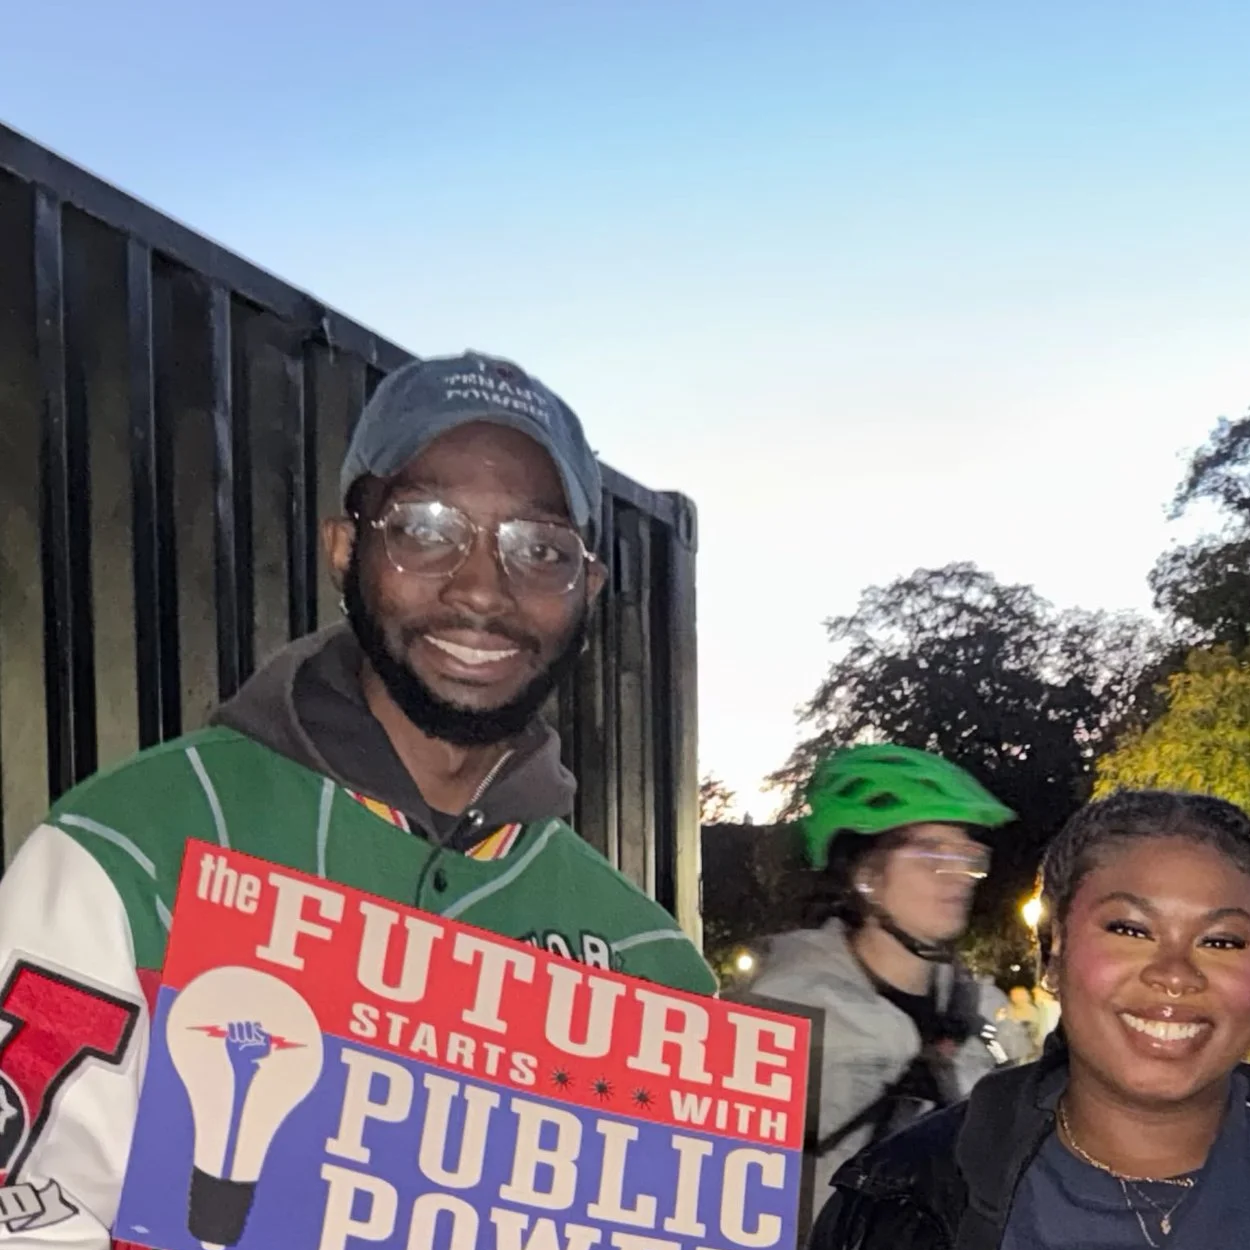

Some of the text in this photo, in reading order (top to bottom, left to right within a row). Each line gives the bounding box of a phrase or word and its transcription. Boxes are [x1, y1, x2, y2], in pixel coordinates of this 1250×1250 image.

[197, 854, 797, 1102] the FUTURE
[349, 1002, 788, 1142] STARTS WITH
[325, 1046, 787, 1250] PUBLIC
